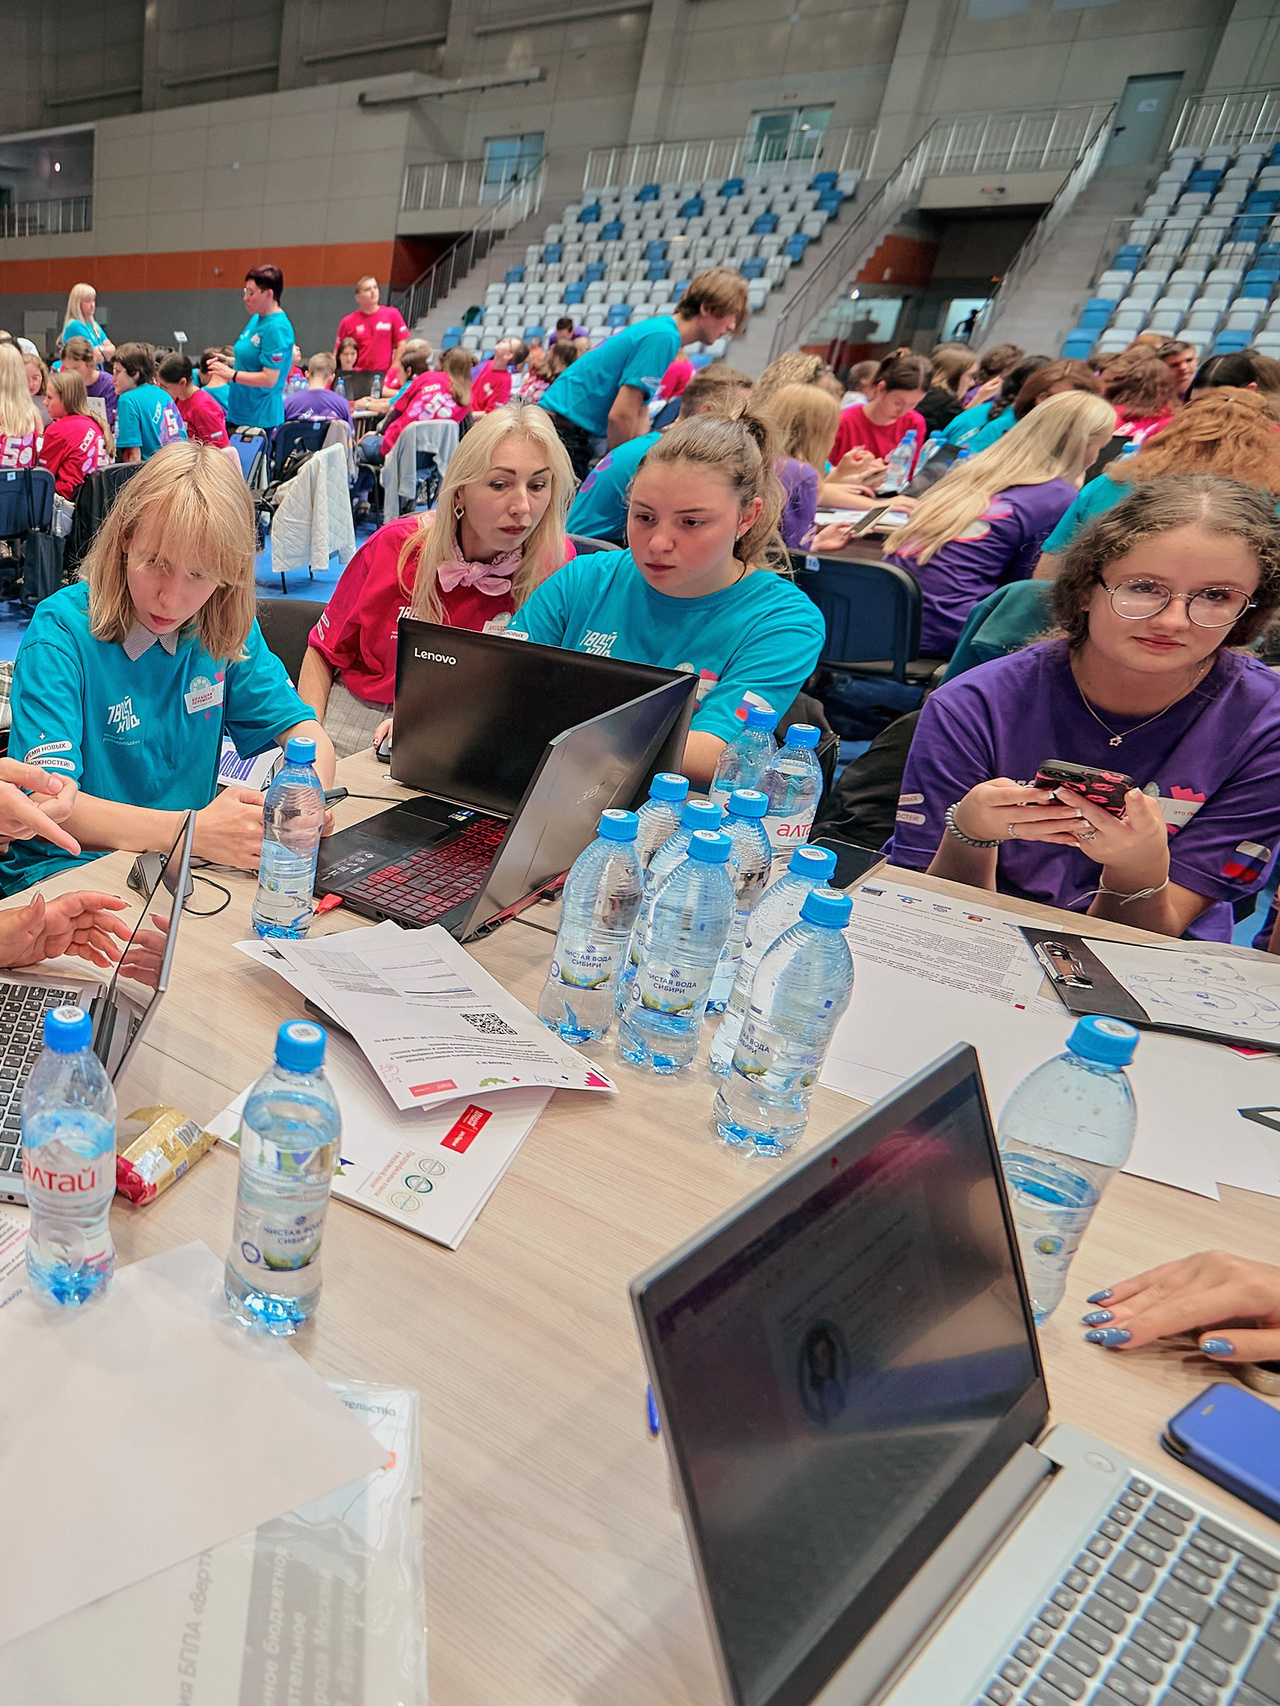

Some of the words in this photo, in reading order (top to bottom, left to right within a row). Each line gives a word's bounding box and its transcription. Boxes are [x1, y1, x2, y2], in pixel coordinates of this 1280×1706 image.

[1, 437, 20, 467] 5
[414, 648, 457, 665] Lenovo
[41, 743, 67, 753] НОВЫХ
[564, 949, 591, 962] ЧИСТАЯ
[592, 954, 612, 962] ВОДА
[571, 959, 602, 968] СИБИРИ
[647, 971, 673, 986] ЧИСТАЯ
[675, 980, 698, 988] ВОДА
[653, 982, 686, 994] СИБИРИ
[749, 1038, 770, 1053] ВОДА
[341, 1399, 397, 1416] тельство
[262, 1545, 288, 1655] бюджетное
[177, 1620, 203, 1678] БПЛА
